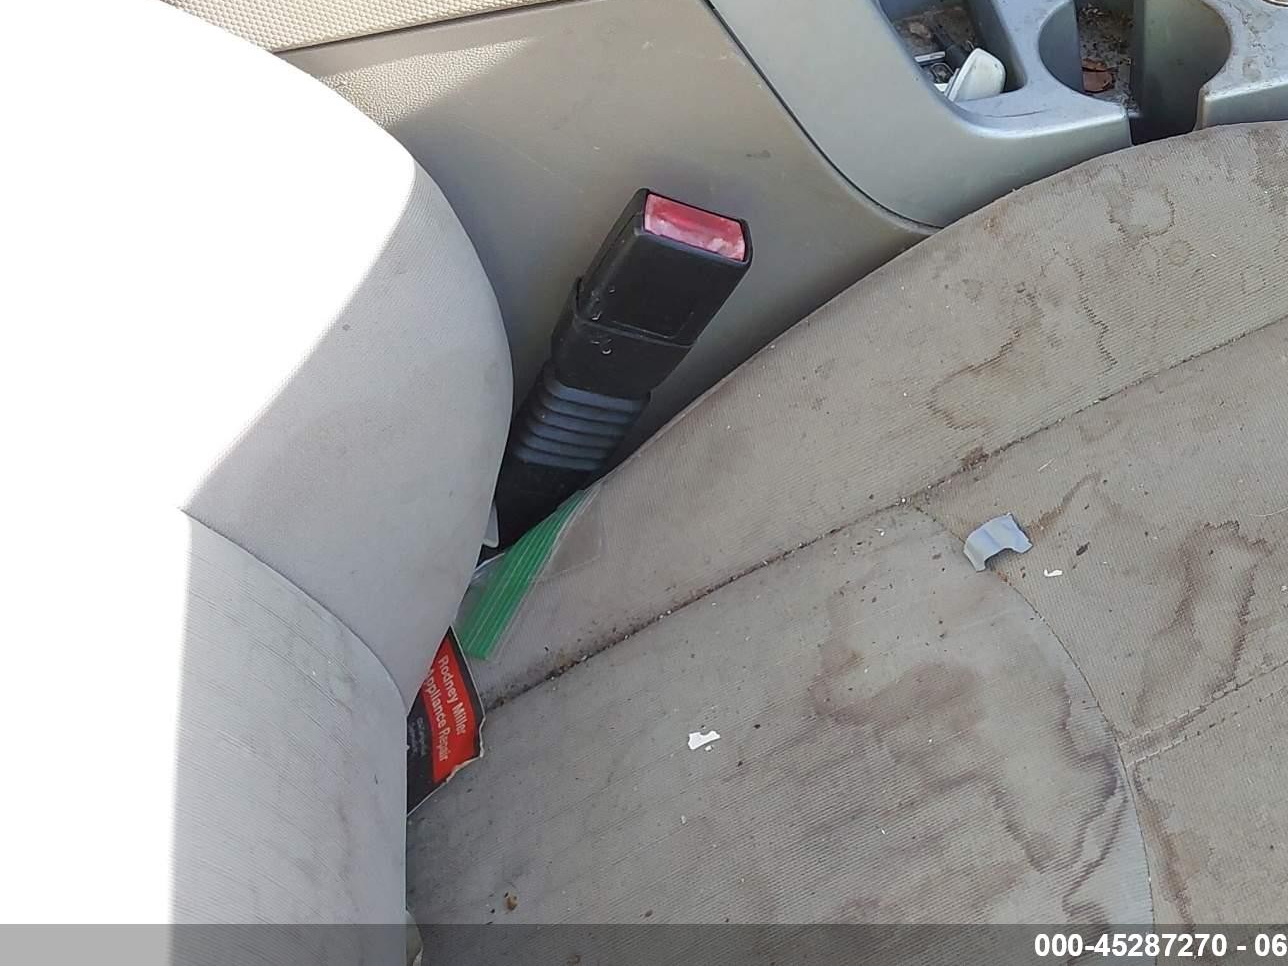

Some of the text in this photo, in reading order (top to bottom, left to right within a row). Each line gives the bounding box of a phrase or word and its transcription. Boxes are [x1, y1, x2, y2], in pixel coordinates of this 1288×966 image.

[437, 654, 468, 736] Rodney Miller
[437, 727, 451, 762] Repair
